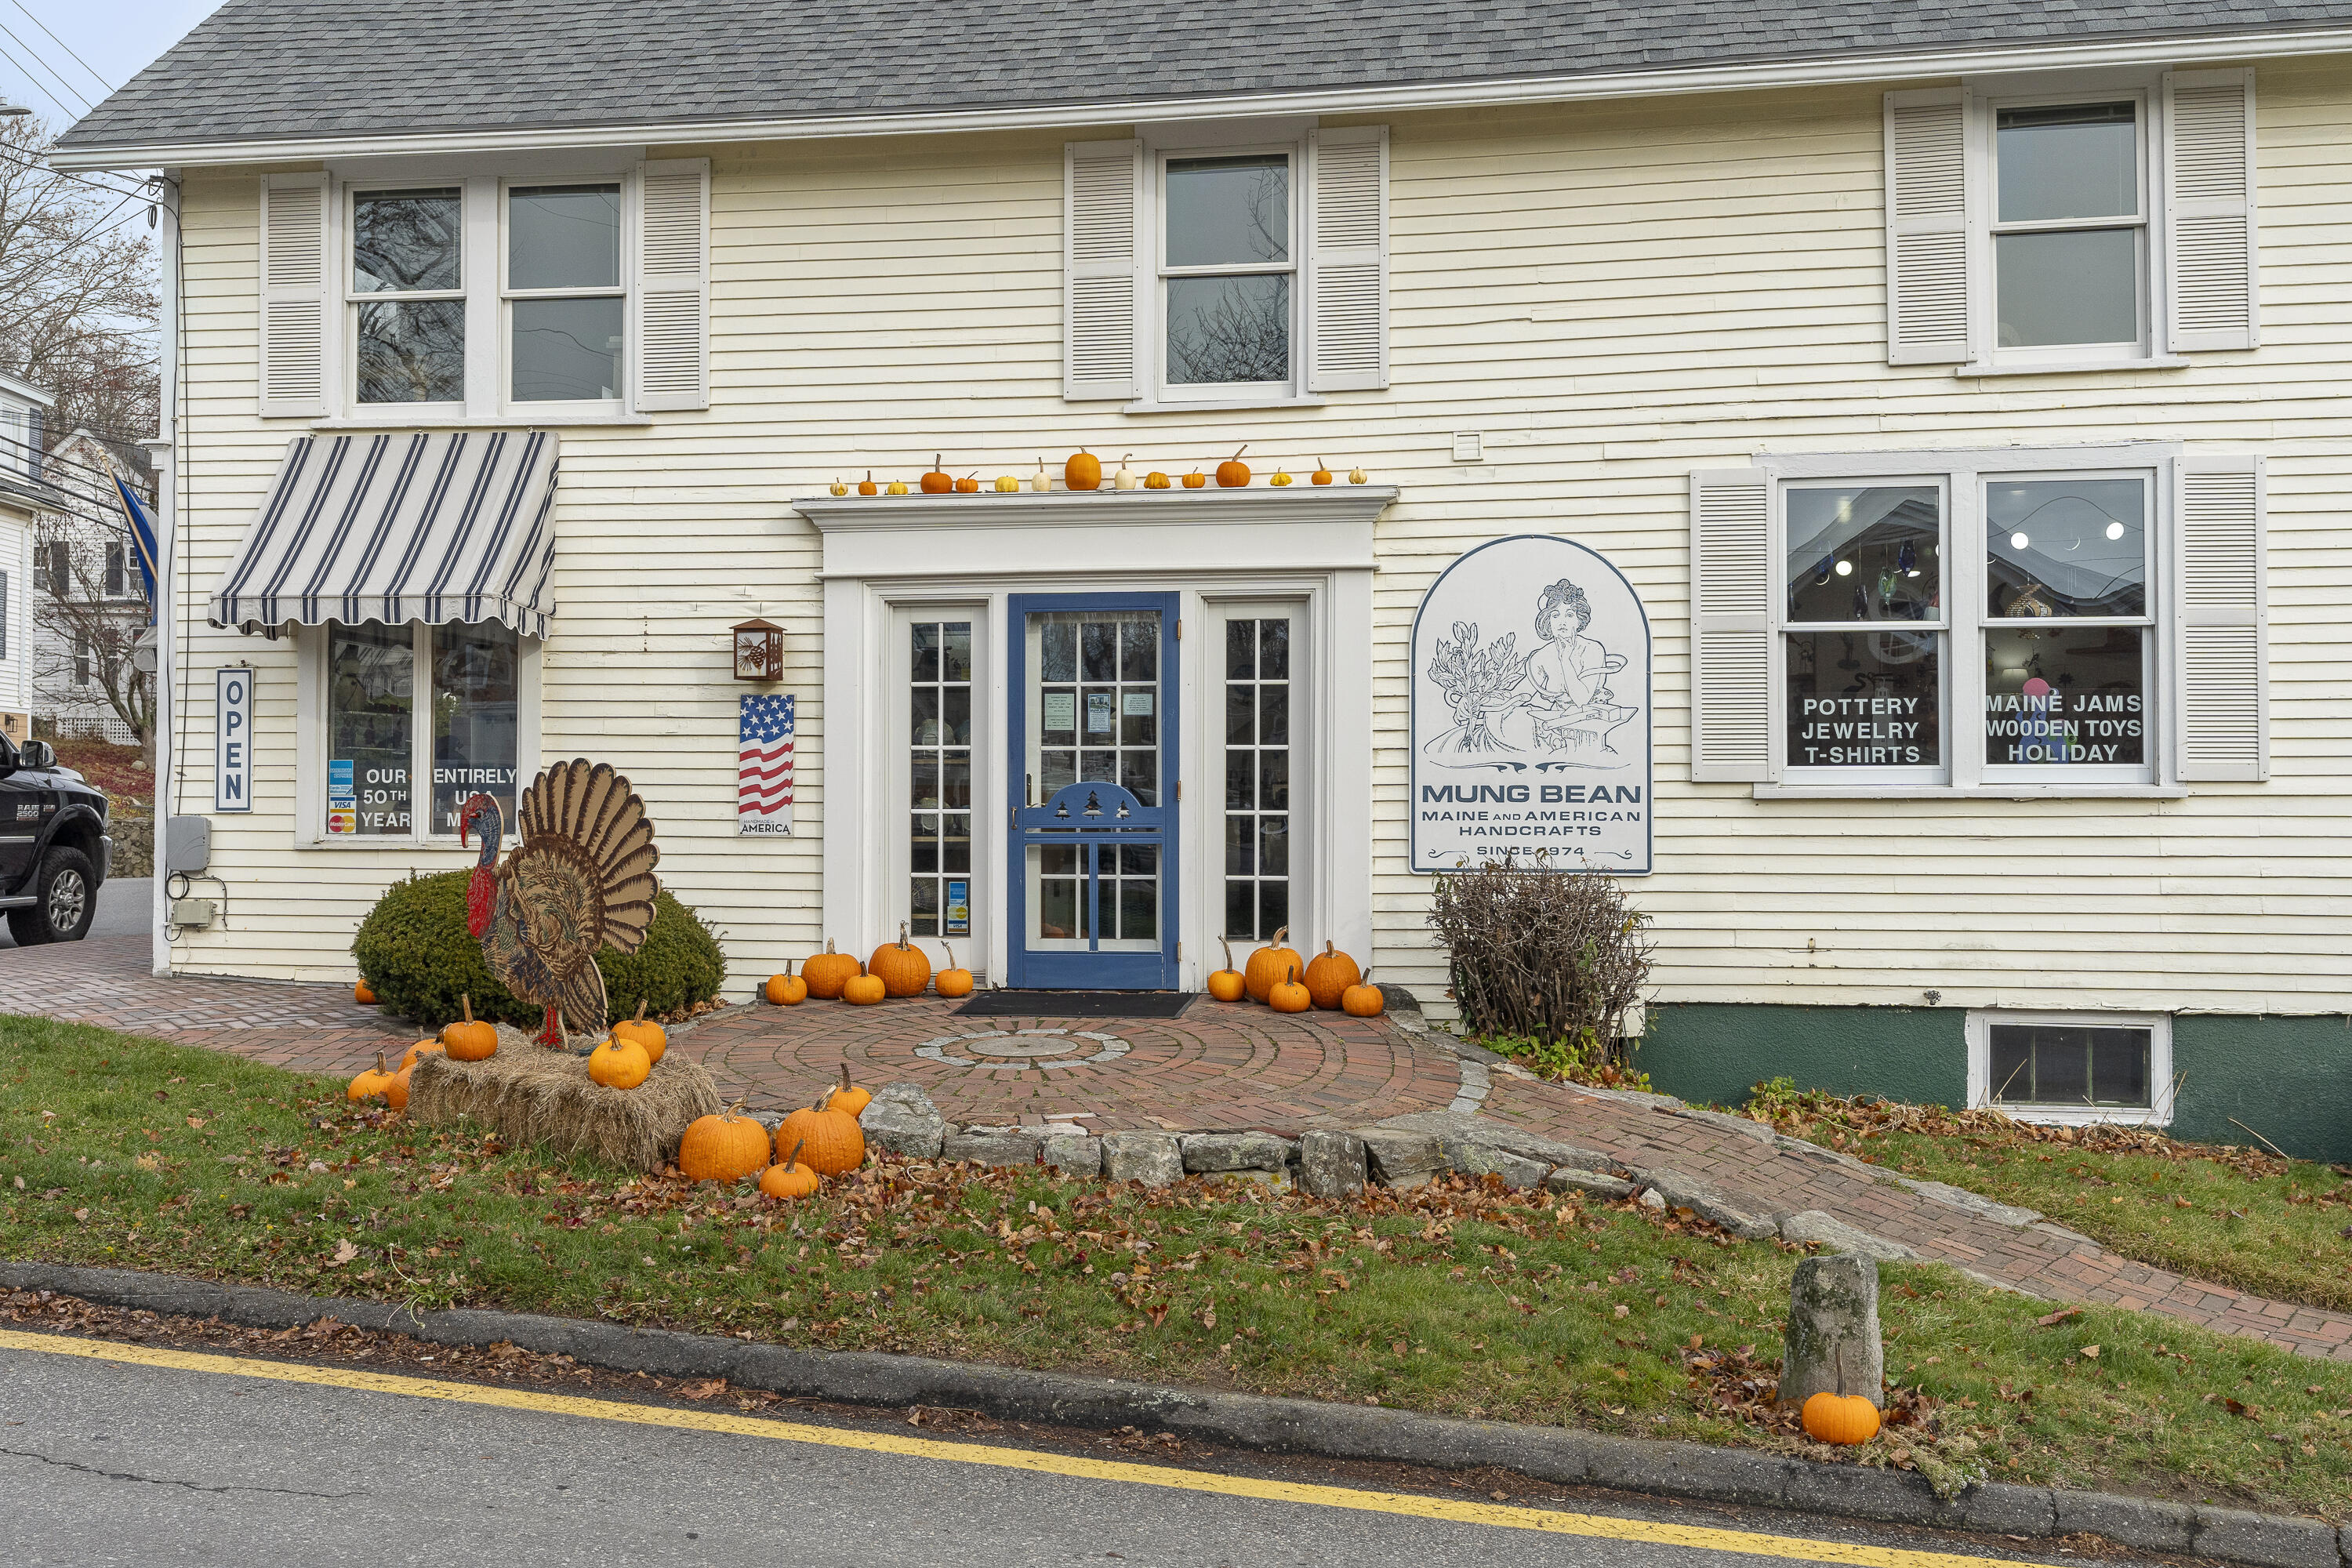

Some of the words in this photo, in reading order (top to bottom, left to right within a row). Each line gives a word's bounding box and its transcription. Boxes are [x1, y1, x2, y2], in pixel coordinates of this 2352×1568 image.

[1804, 698, 1918, 715] POTTERY
[1986, 695, 2063, 712] MAINE
[2073, 695, 2142, 712] JAMS
[1802, 722, 1919, 739] JEWELRY
[1986, 720, 2078, 736] WOODEN
[2085, 719, 2142, 736] TOYS
[225, 681, 243, 799] OPEN
[1805, 746, 1920, 764] T-SHIRTS
[2009, 745, 2118, 761] HOLIDAY
[366, 769, 406, 783] OUR
[434, 768, 517, 783] ENTIRELY
[1422, 785, 1530, 803] MUNG
[1540, 785, 1641, 804] BEAN
[361, 811, 411, 827] YEAR
[1422, 811, 1489, 822] MAINE
[1524, 811, 1641, 822] AMERICAN
[742, 824, 790, 833] AMERICA
[1459, 826, 1602, 836] HANDCRAFTS
[1476, 846, 1532, 855] SINCE
[1543, 847, 1584, 855] 974
